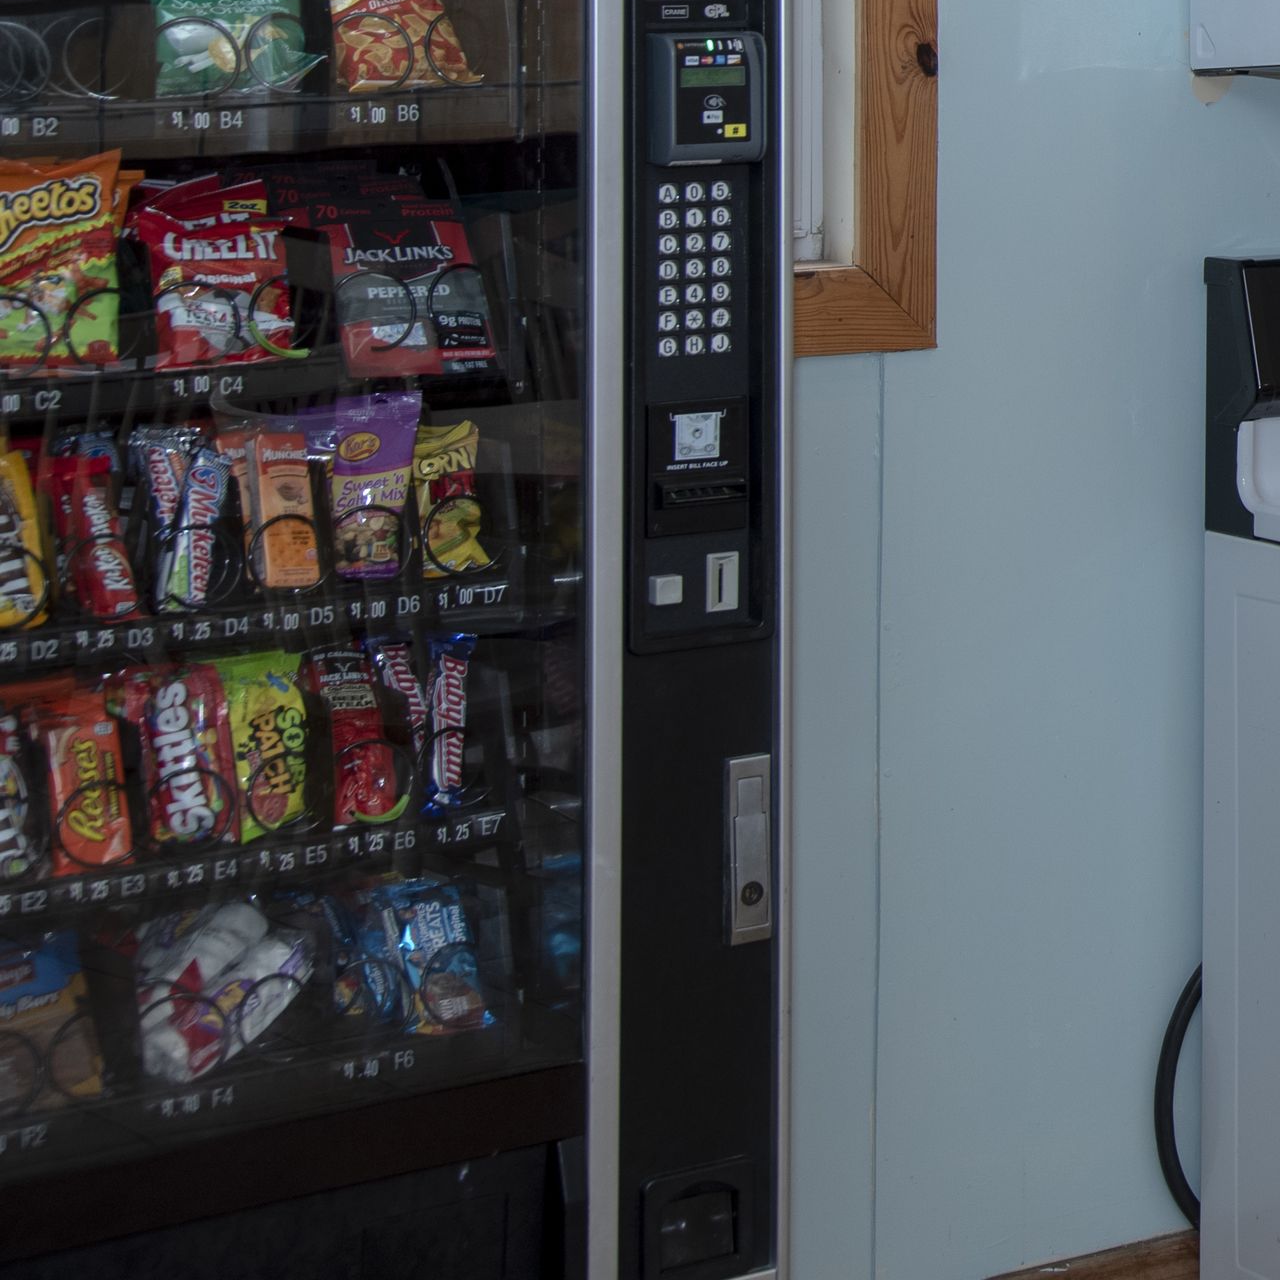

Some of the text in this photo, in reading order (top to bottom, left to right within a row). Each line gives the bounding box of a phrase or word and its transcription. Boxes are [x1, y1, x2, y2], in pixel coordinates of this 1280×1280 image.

[220, 111, 244, 130] B4
[397, 105, 420, 123] B6
[32, 116, 59, 138] B2
[277, 189, 298, 204] 70
[664, 187, 672, 197] A
[717, 184, 724, 197] 5
[315, 205, 455, 219] 70 Protein
[664, 210, 724, 226] B 1 6
[664, 235, 724, 251] C 2 7
[344, 245, 454, 264] JACK LINK'S
[664, 260, 724, 277] D 3 8
[664, 286, 724, 302] E 4 9
[438, 314, 457, 328] 9g
[664, 315, 672, 328] F
[663, 336, 724, 354] G H J
[220, 376, 244, 395] C4
[34, 389, 63, 410] C2
[344, 437, 377, 454] Kar's
[666, 463, 688, 471] INSERT
[190, 467, 218, 490] 3
[342, 477, 389, 496] Sweet
[335, 488, 405, 513] Salty Mix
[397, 595, 421, 614] D6
[484, 586, 508, 604] D7
[310, 606, 335, 626] D5
[224, 618, 249, 637] D4
[127, 627, 154, 648] D3
[31, 638, 59, 661] D2
[437, 653, 470, 727] Baby
[152, 681, 216, 834] Skittles
[394, 830, 416, 850] E6
[305, 844, 328, 866] E5
[214, 858, 239, 881] E4
[120, 873, 147, 897] E3
[20, 889, 49, 914] E2
[425, 900, 447, 949] REATS
[394, 1049, 415, 1070] F6
[211, 1085, 234, 1109] F4
[20, 1122, 48, 1148] F2
